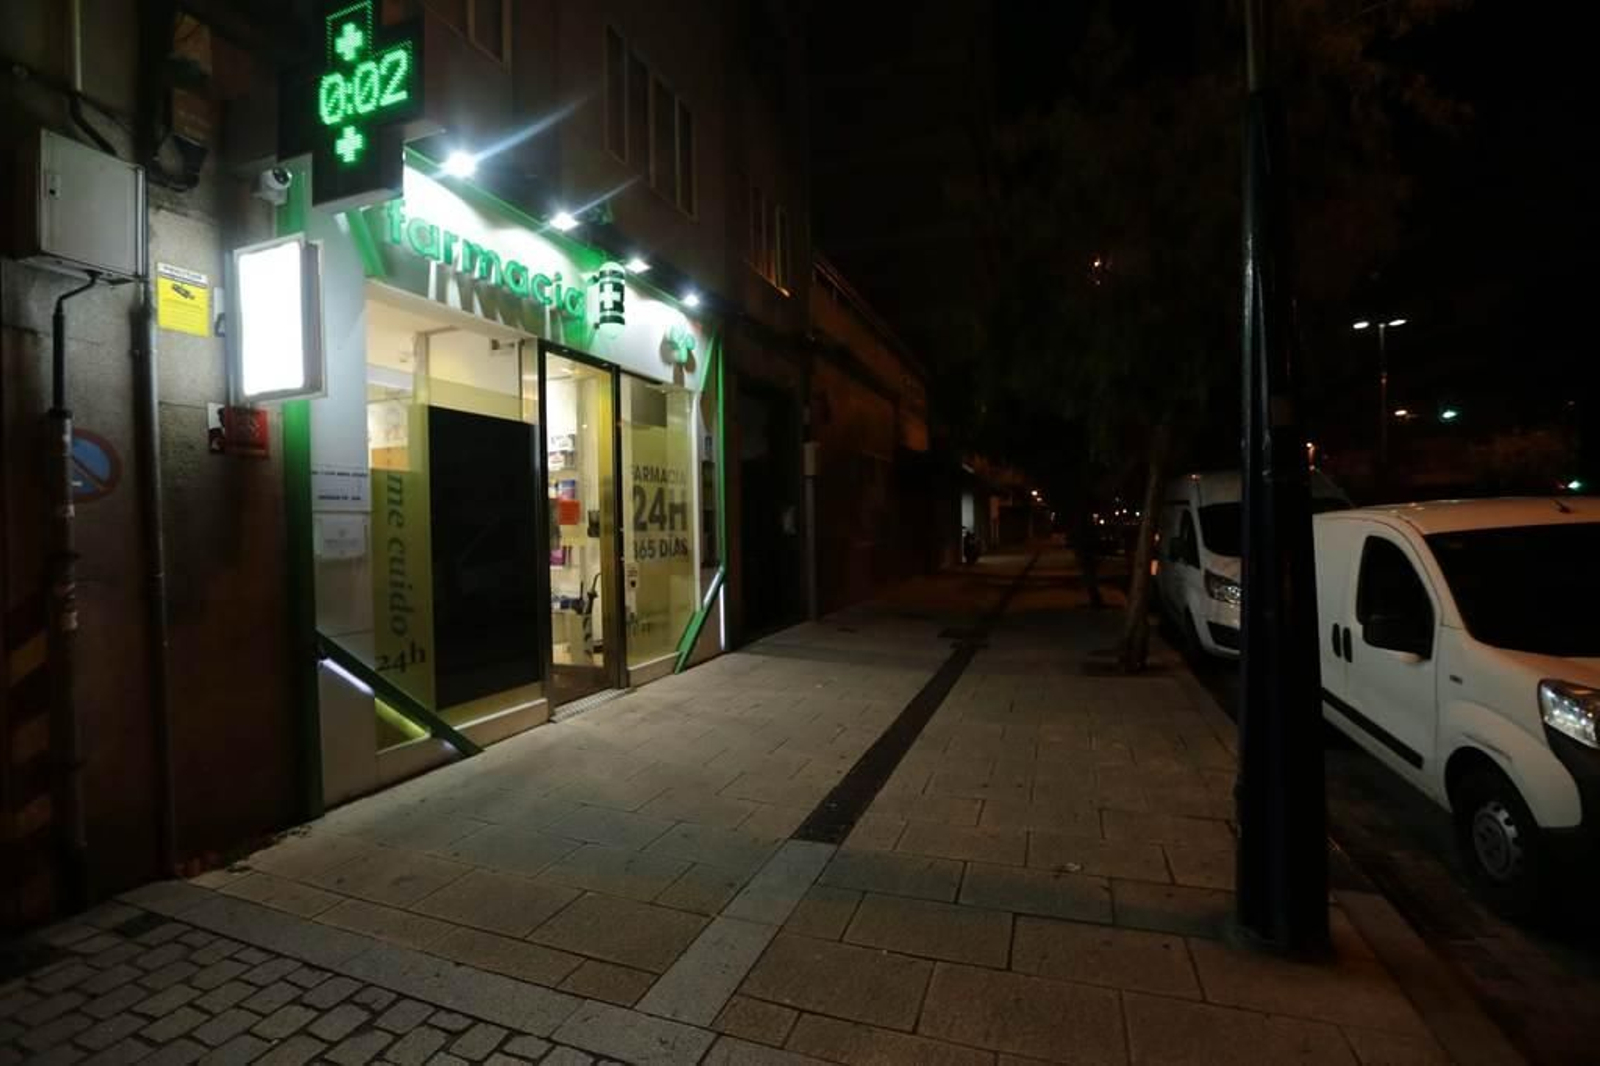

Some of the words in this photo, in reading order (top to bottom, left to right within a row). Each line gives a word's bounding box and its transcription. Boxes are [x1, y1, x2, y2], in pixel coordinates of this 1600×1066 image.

[319, 49, 408, 125] 0:02
[384, 198, 585, 318] farmacia
[387, 474, 405, 528] me
[633, 485, 688, 532] 24H
[388, 537, 415, 636] cuido
[375, 640, 426, 674] 24h
